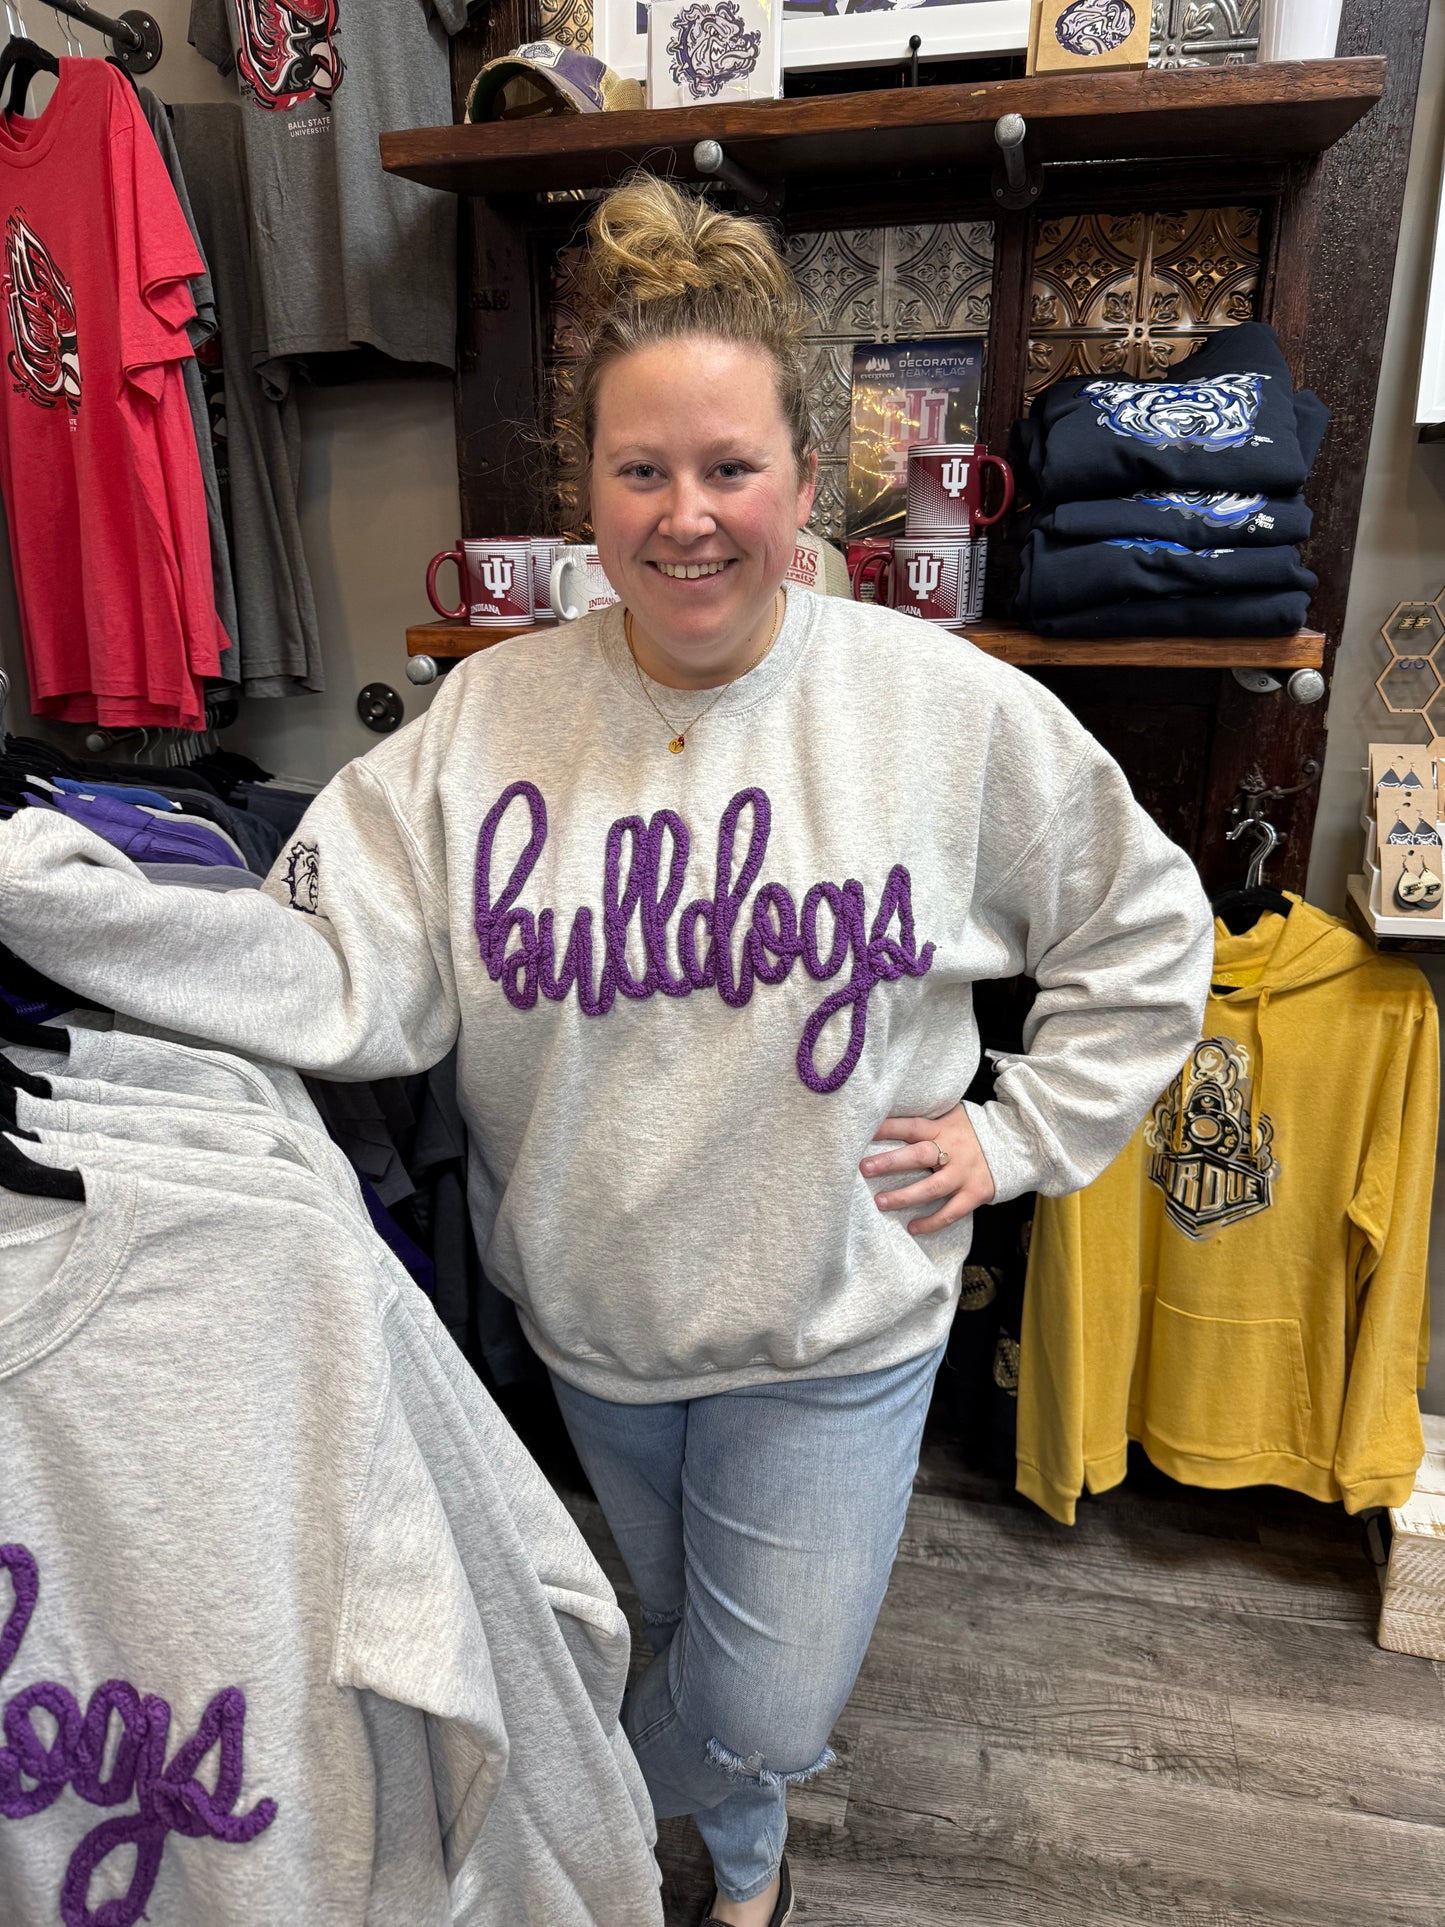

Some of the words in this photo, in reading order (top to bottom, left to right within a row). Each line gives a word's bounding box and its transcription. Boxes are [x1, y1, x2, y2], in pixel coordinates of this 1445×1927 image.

[288, 120, 307, 130] BALL
[308, 116, 331, 127] STATE
[290, 126, 330, 138] UNIVERSITY
[899, 358, 974, 368] DECORATIVE
[860, 372, 895, 380] evergreen
[900, 369, 930, 378] TEAM
[935, 367, 966, 376] FLAG
[589, 597, 617, 609] INDIAN
[470, 603, 501, 616] INDIANA
[474, 780, 936, 1094] bulldogs
